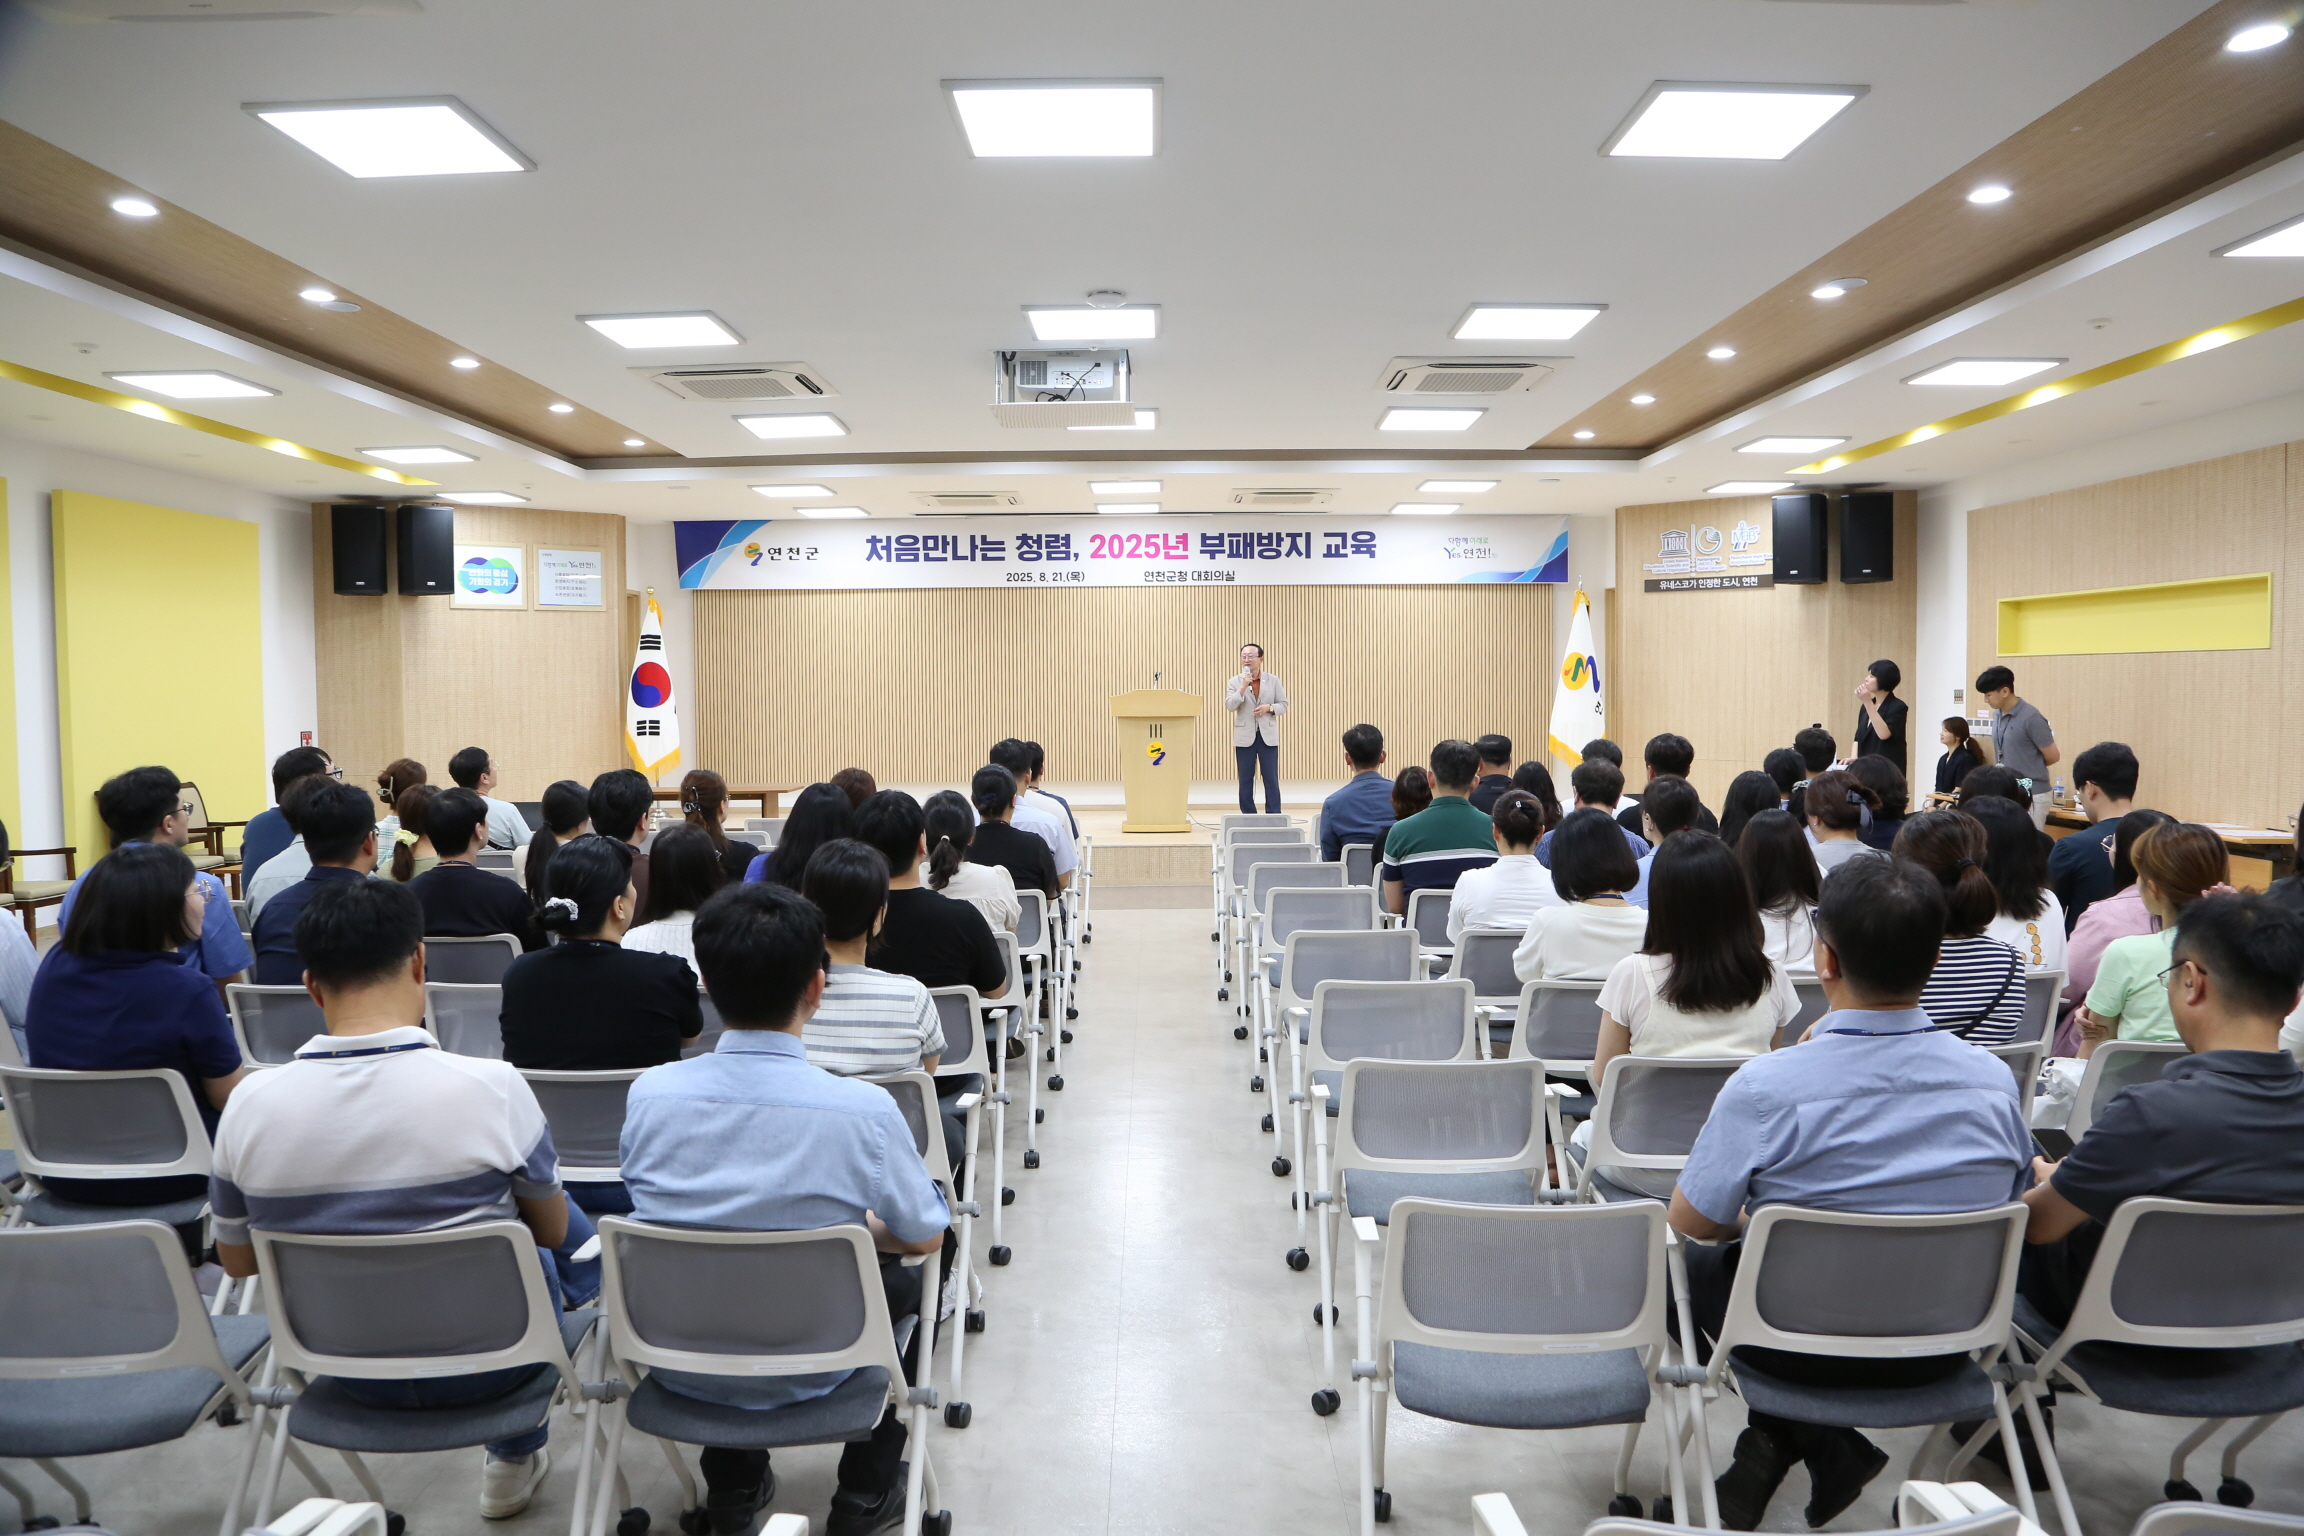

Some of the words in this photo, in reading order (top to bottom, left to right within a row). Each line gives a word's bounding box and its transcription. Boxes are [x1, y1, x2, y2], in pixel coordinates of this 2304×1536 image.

[866, 534, 1007, 563] 처음만나는
[1015, 533, 1080, 562] 청렴,
[1089, 533, 1189, 560] 2025년
[1199, 531, 1312, 560] 부패방지
[1322, 531, 1377, 559] 교육
[767, 547, 819, 561] 연천군
[493, 568, 509, 577] 중심
[1006, 572, 1036, 582] 2025.
[1039, 572, 1049, 582] 8.
[1052, 571, 1085, 582] 21.(목)
[1143, 570, 1188, 583] 연천군청
[1191, 570, 1236, 582] 대회의실
[468, 577, 492, 586] 기회의
[493, 577, 509, 586] 경기
[1659, 579, 1697, 590] 유네스코가
[1698, 578, 1721, 589] 인정한
[1722, 577, 1741, 587] 도시,
[1742, 576, 1758, 586] 연천
